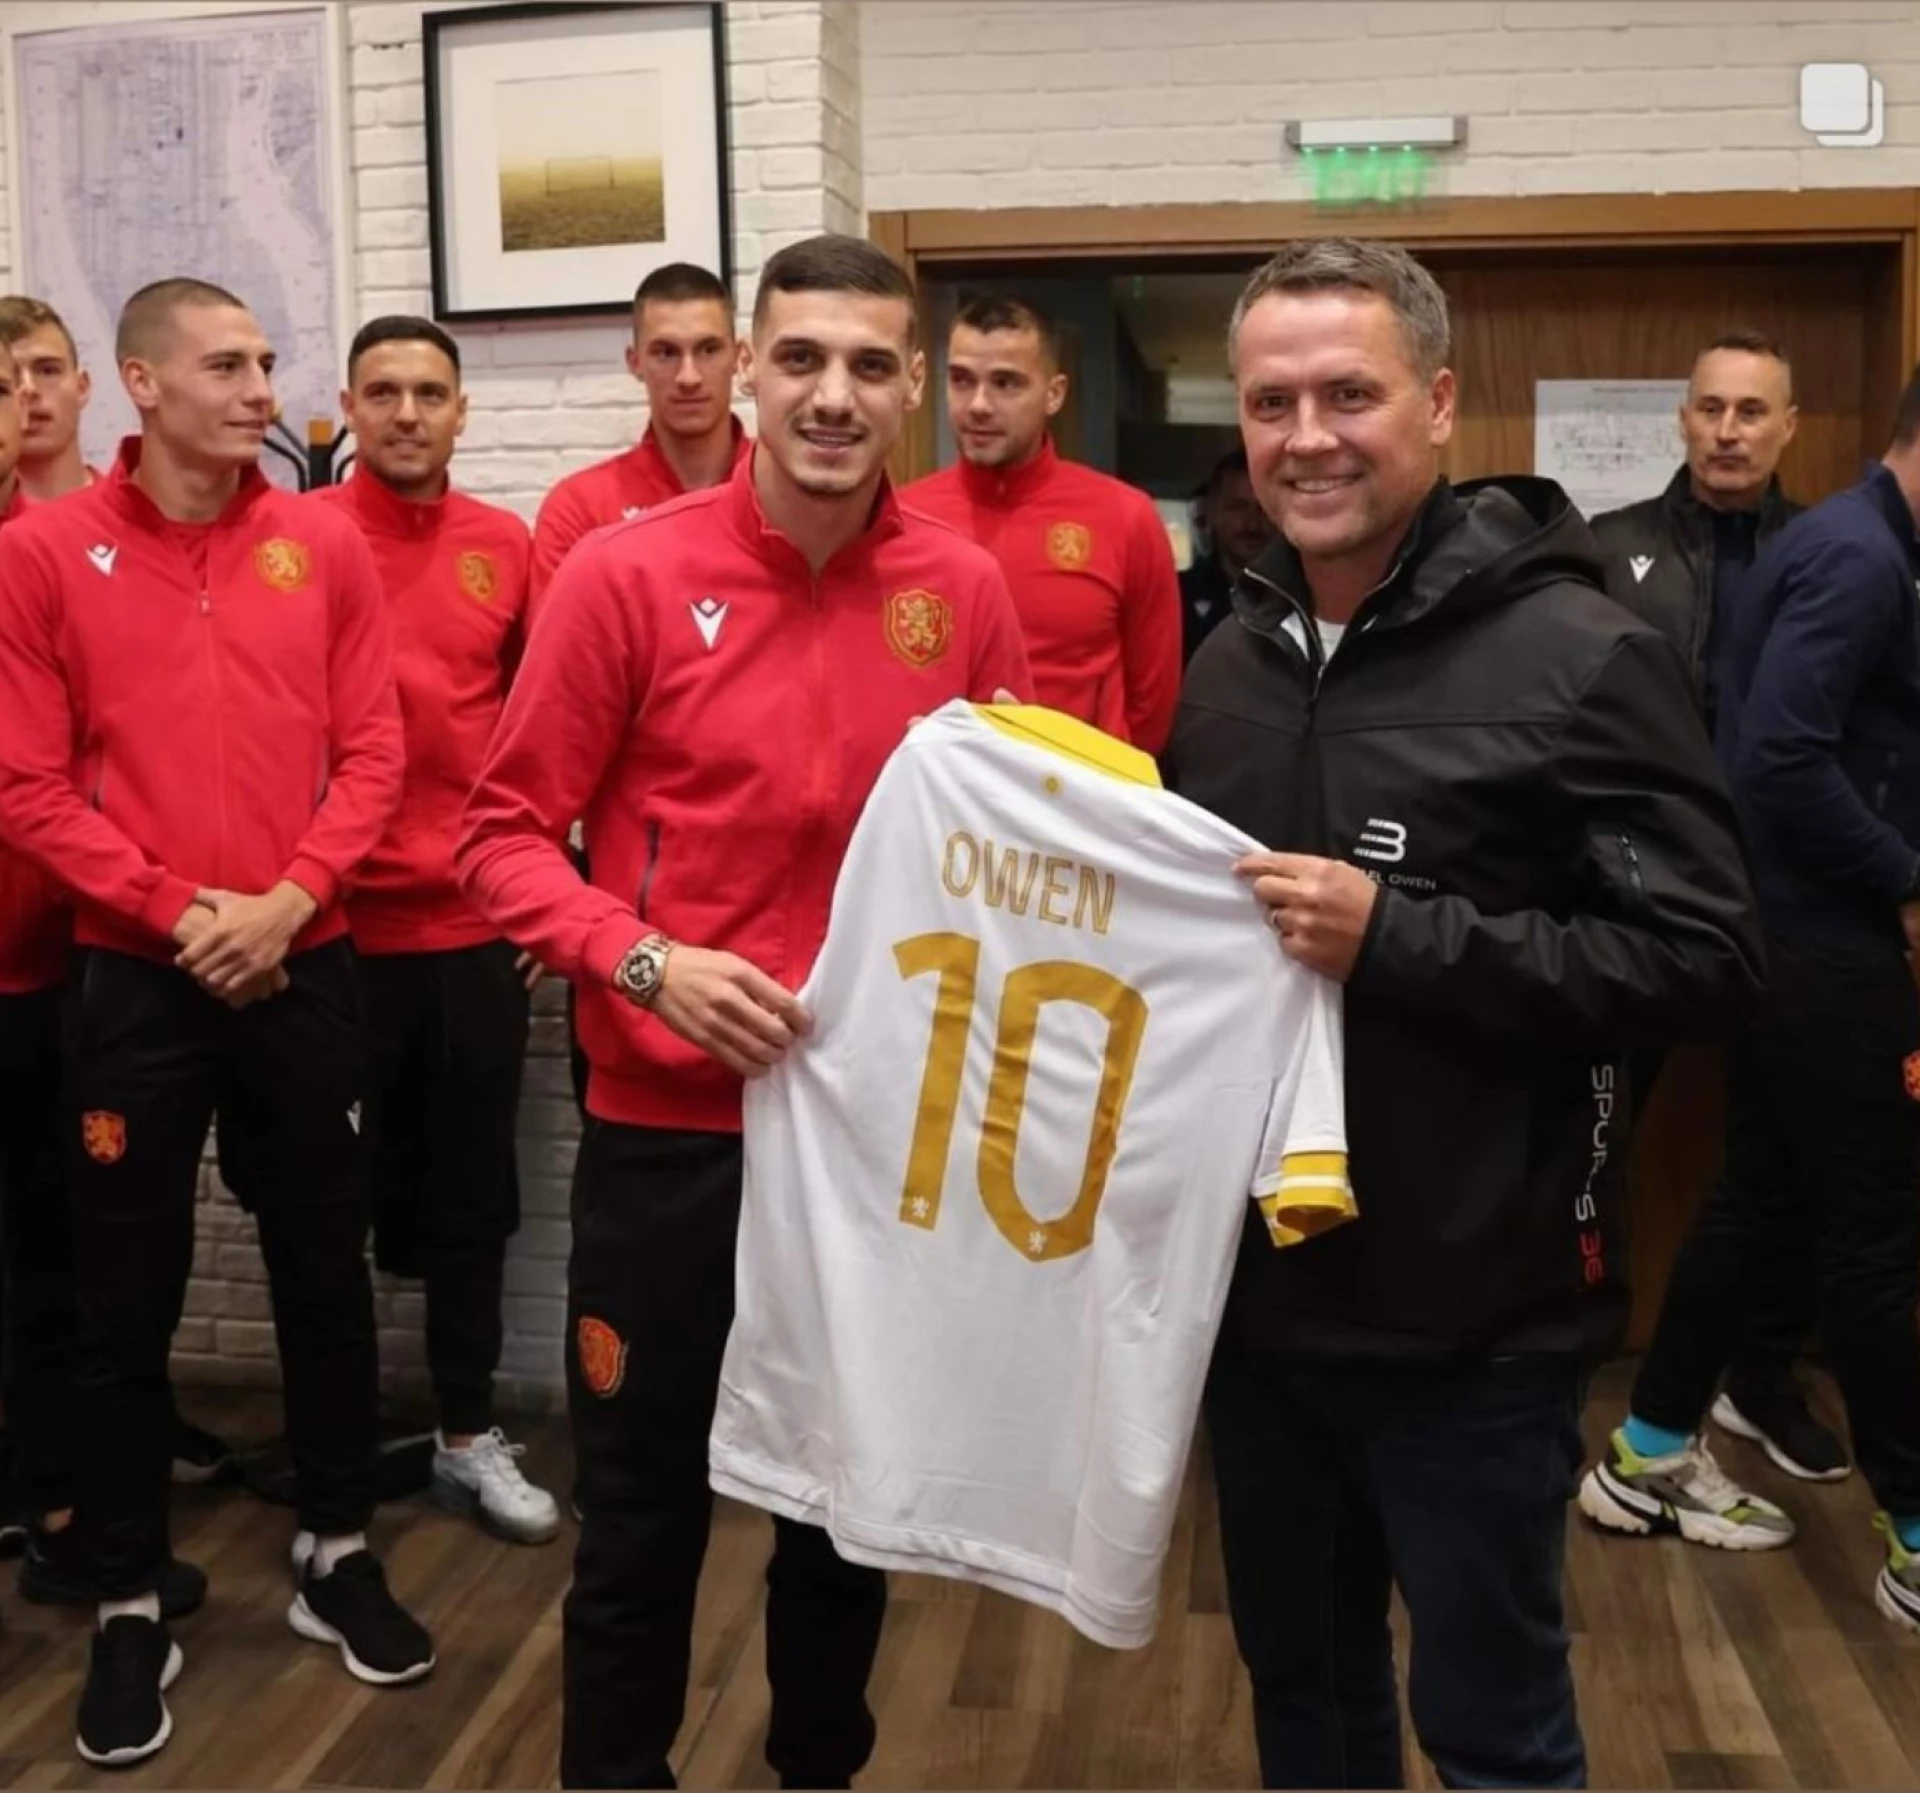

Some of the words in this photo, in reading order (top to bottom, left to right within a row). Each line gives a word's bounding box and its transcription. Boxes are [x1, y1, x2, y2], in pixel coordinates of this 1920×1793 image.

[940, 830, 1116, 934] OWEN
[1388, 873, 1437, 890] OWEN
[892, 931, 1150, 1263] 10
